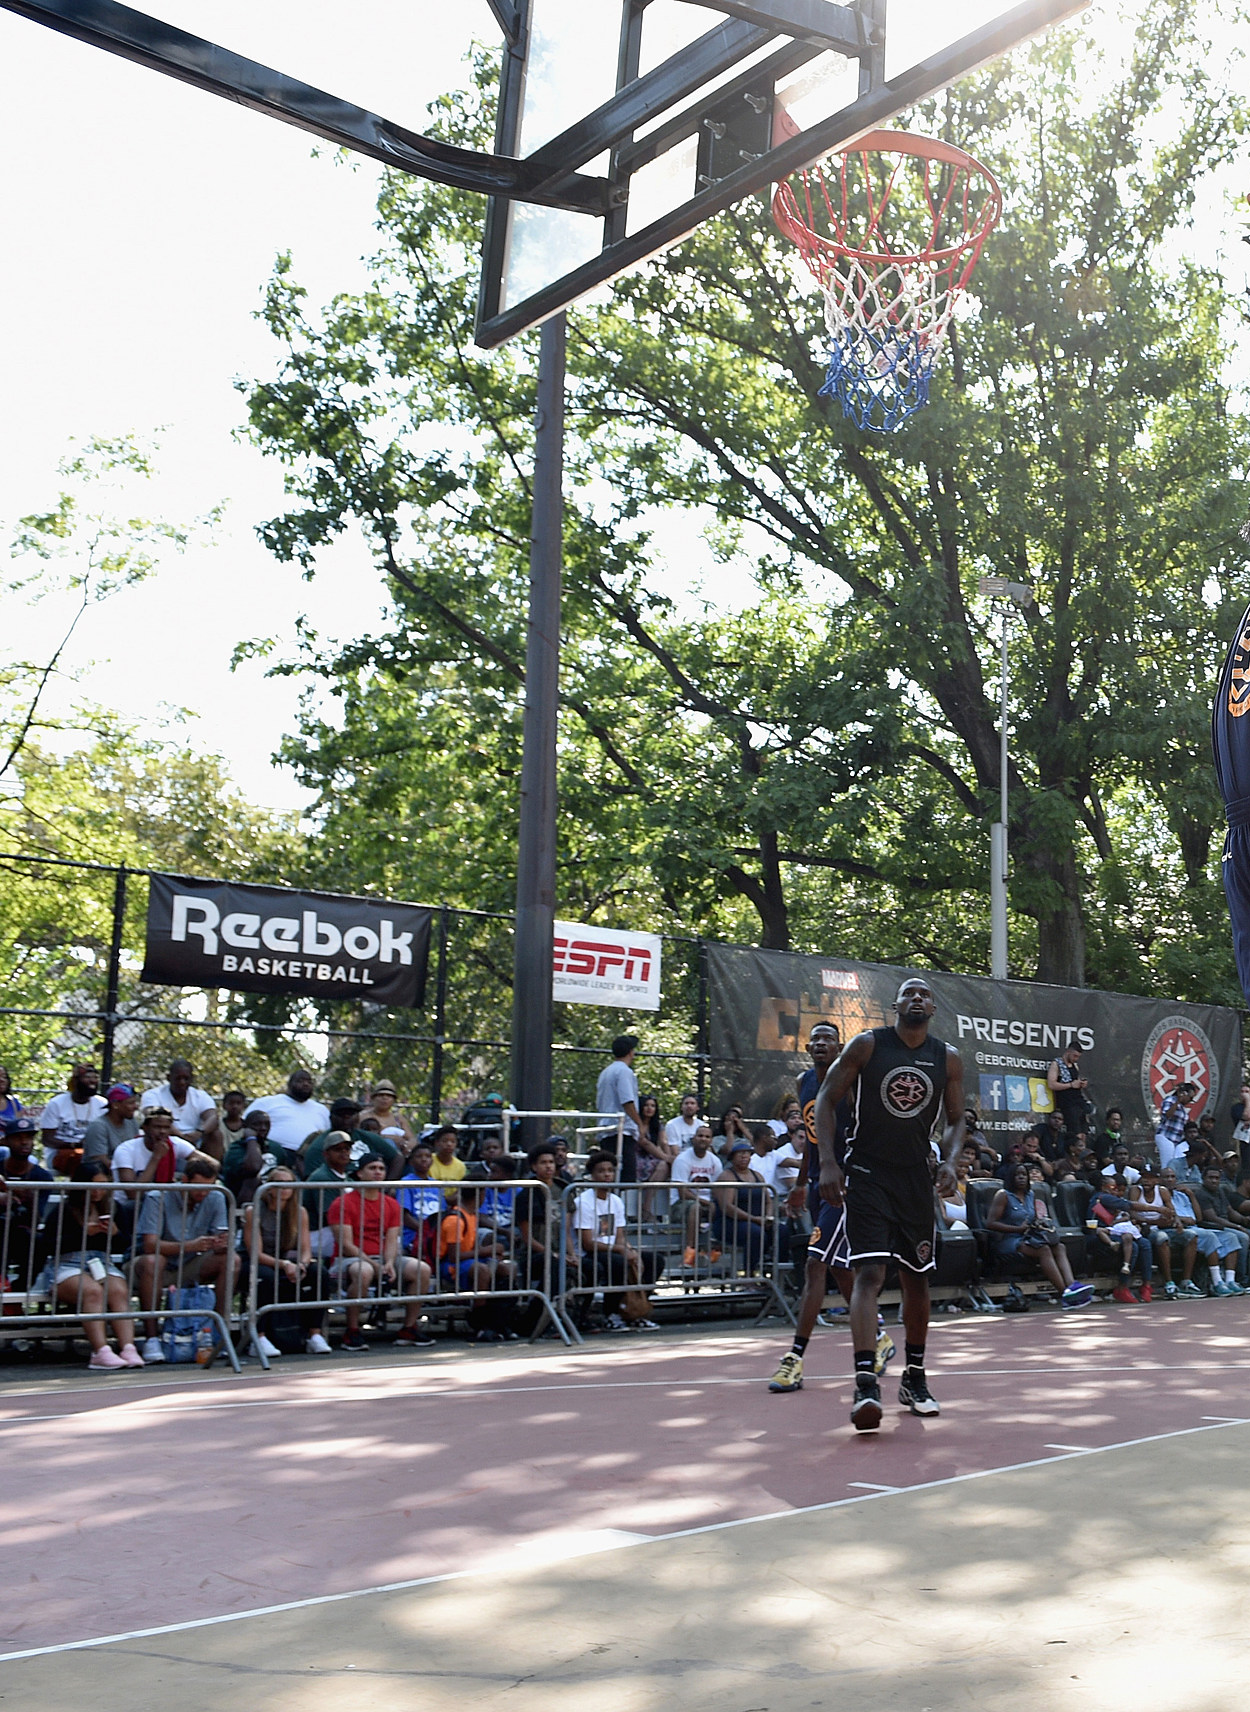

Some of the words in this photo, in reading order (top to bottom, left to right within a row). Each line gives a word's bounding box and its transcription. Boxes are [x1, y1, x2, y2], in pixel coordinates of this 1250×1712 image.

[171, 895, 413, 965] Reebok
[223, 955, 374, 985] BASKETBALL
[553, 938, 651, 982] ESPN
[553, 977, 589, 988] ORLDWIDE
[956, 1014, 1095, 1050] PRESENTS
